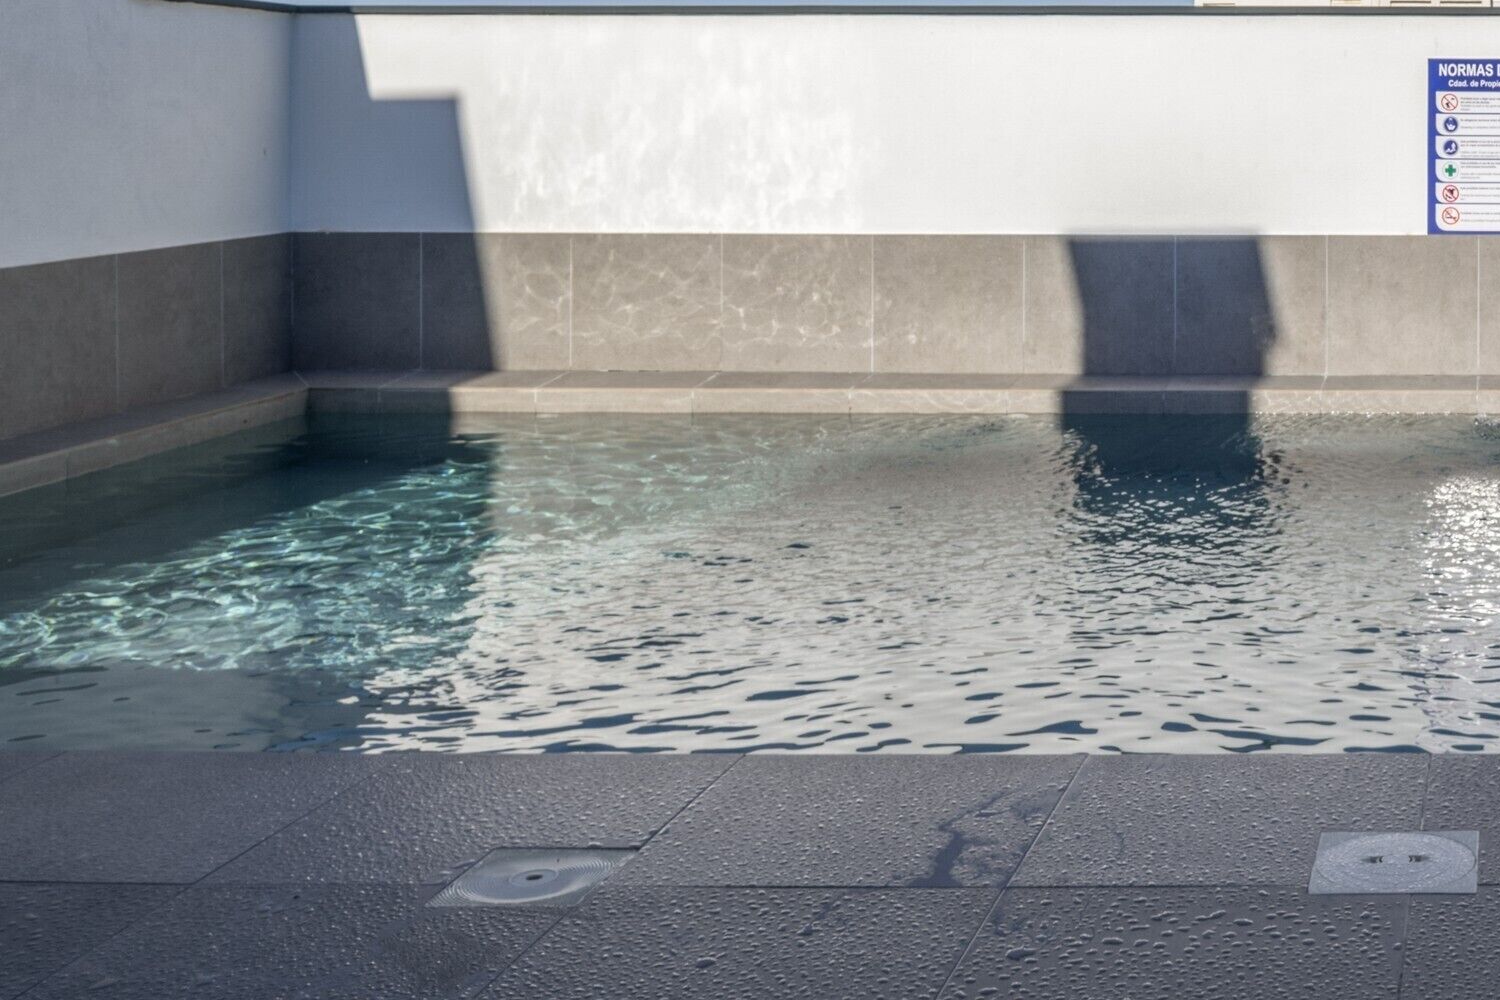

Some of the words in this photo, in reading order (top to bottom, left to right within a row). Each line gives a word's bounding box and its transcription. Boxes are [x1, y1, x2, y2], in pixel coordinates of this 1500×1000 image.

[1438, 63, 1494, 77] NORMAS
[1448, 79, 1469, 87] Cdad.
[1470, 79, 1479, 87] de
